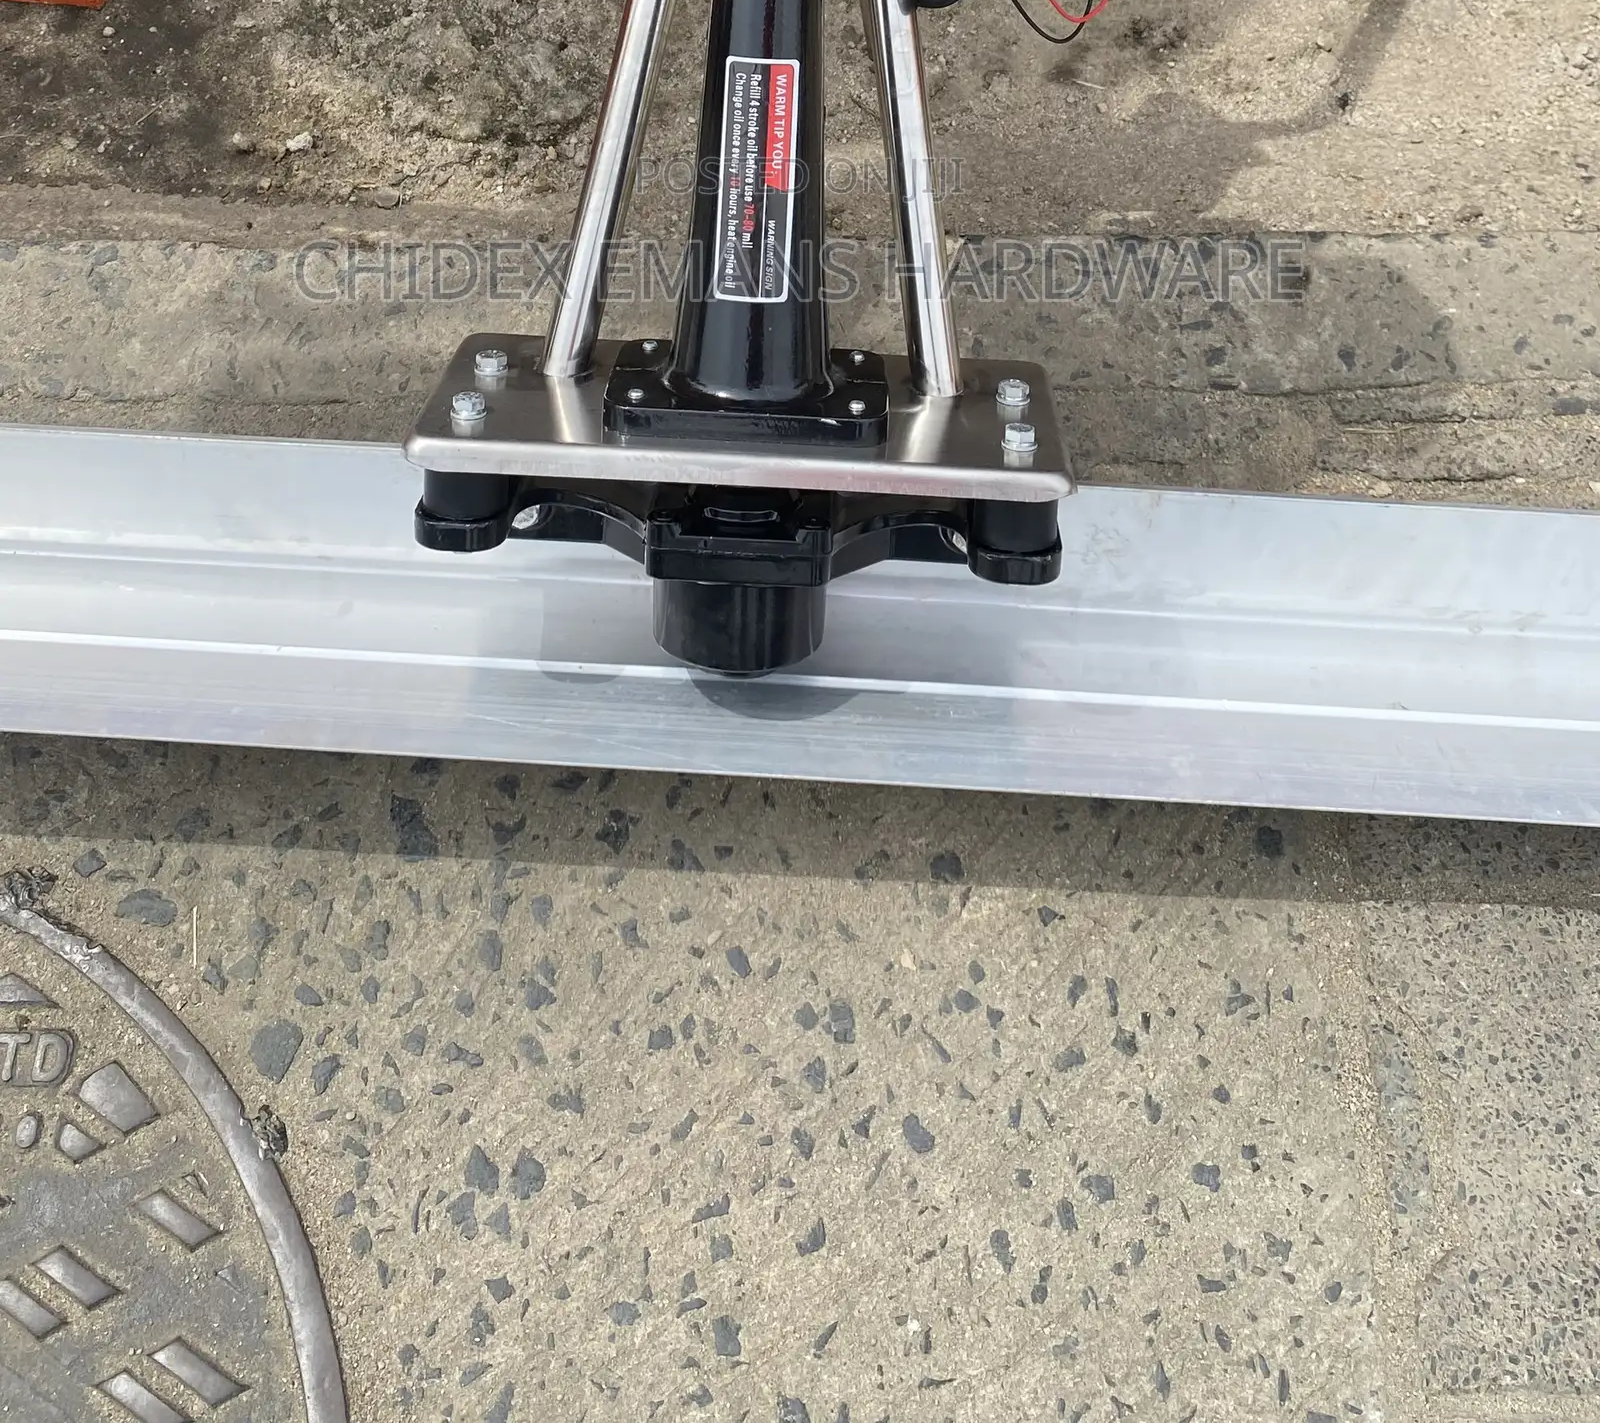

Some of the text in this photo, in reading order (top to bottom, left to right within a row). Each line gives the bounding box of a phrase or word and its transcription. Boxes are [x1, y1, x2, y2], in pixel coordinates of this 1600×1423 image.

[732, 73, 746, 108] Change
[750, 74, 762, 99] Refill
[775, 74, 787, 115] WARM
[733, 110, 744, 121] oil
[747, 108, 759, 138] stroke
[732, 124, 741, 146] once
[774, 119, 785, 138] TIP
[747, 140, 758, 151] oil
[729, 148, 740, 174] every
[746, 153, 758, 183] before
[727, 188, 740, 217] hours,
[745, 185, 753, 201] use
[727, 219, 739, 240] heat
[766, 220, 776, 265] WARNING
[724, 242, 736, 274] engine
[725, 276, 735, 288] oil
